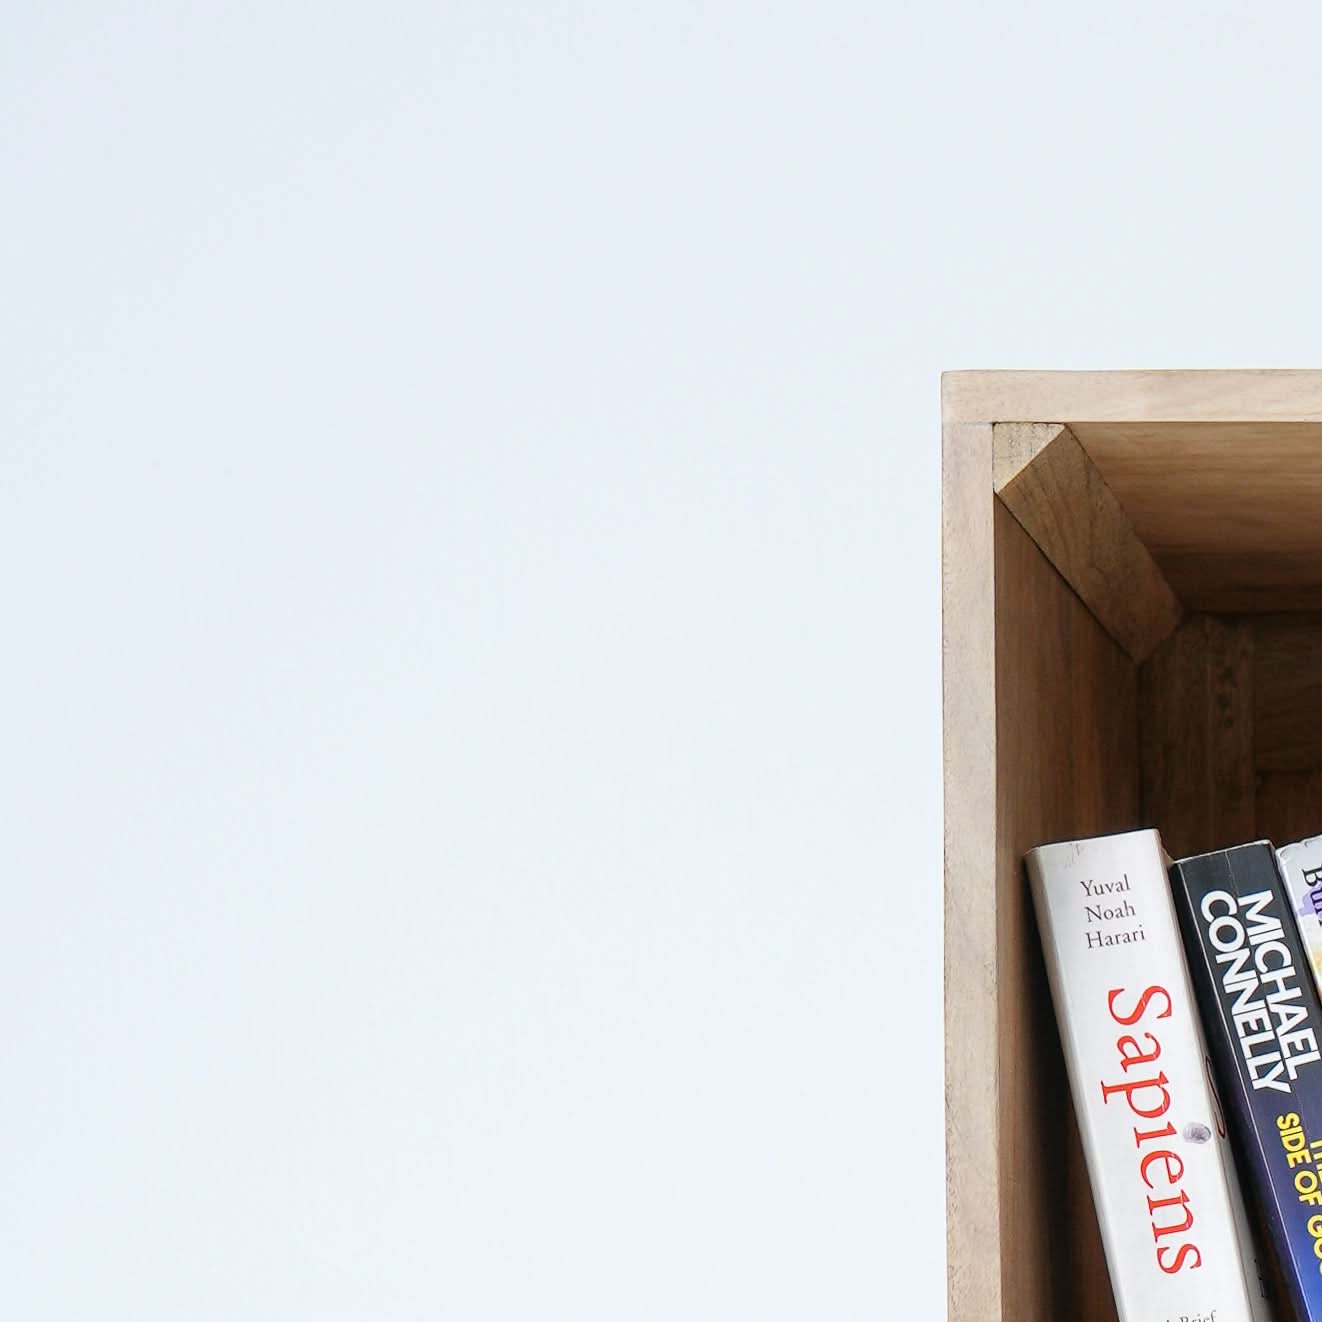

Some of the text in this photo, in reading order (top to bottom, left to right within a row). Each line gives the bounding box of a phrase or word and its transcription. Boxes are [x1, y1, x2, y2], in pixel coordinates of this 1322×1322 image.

[1080, 874, 1130, 898] Yuval
[1084, 905, 1136, 923] Noah
[1085, 923, 1145, 949] Harari
[1200, 889, 1292, 1094] CONNELLY
[1237, 889, 1321, 1080] MICHAEL
[1100, 985, 1201, 1274] Sapiens
[1276, 1112, 1312, 1169] SIDE
